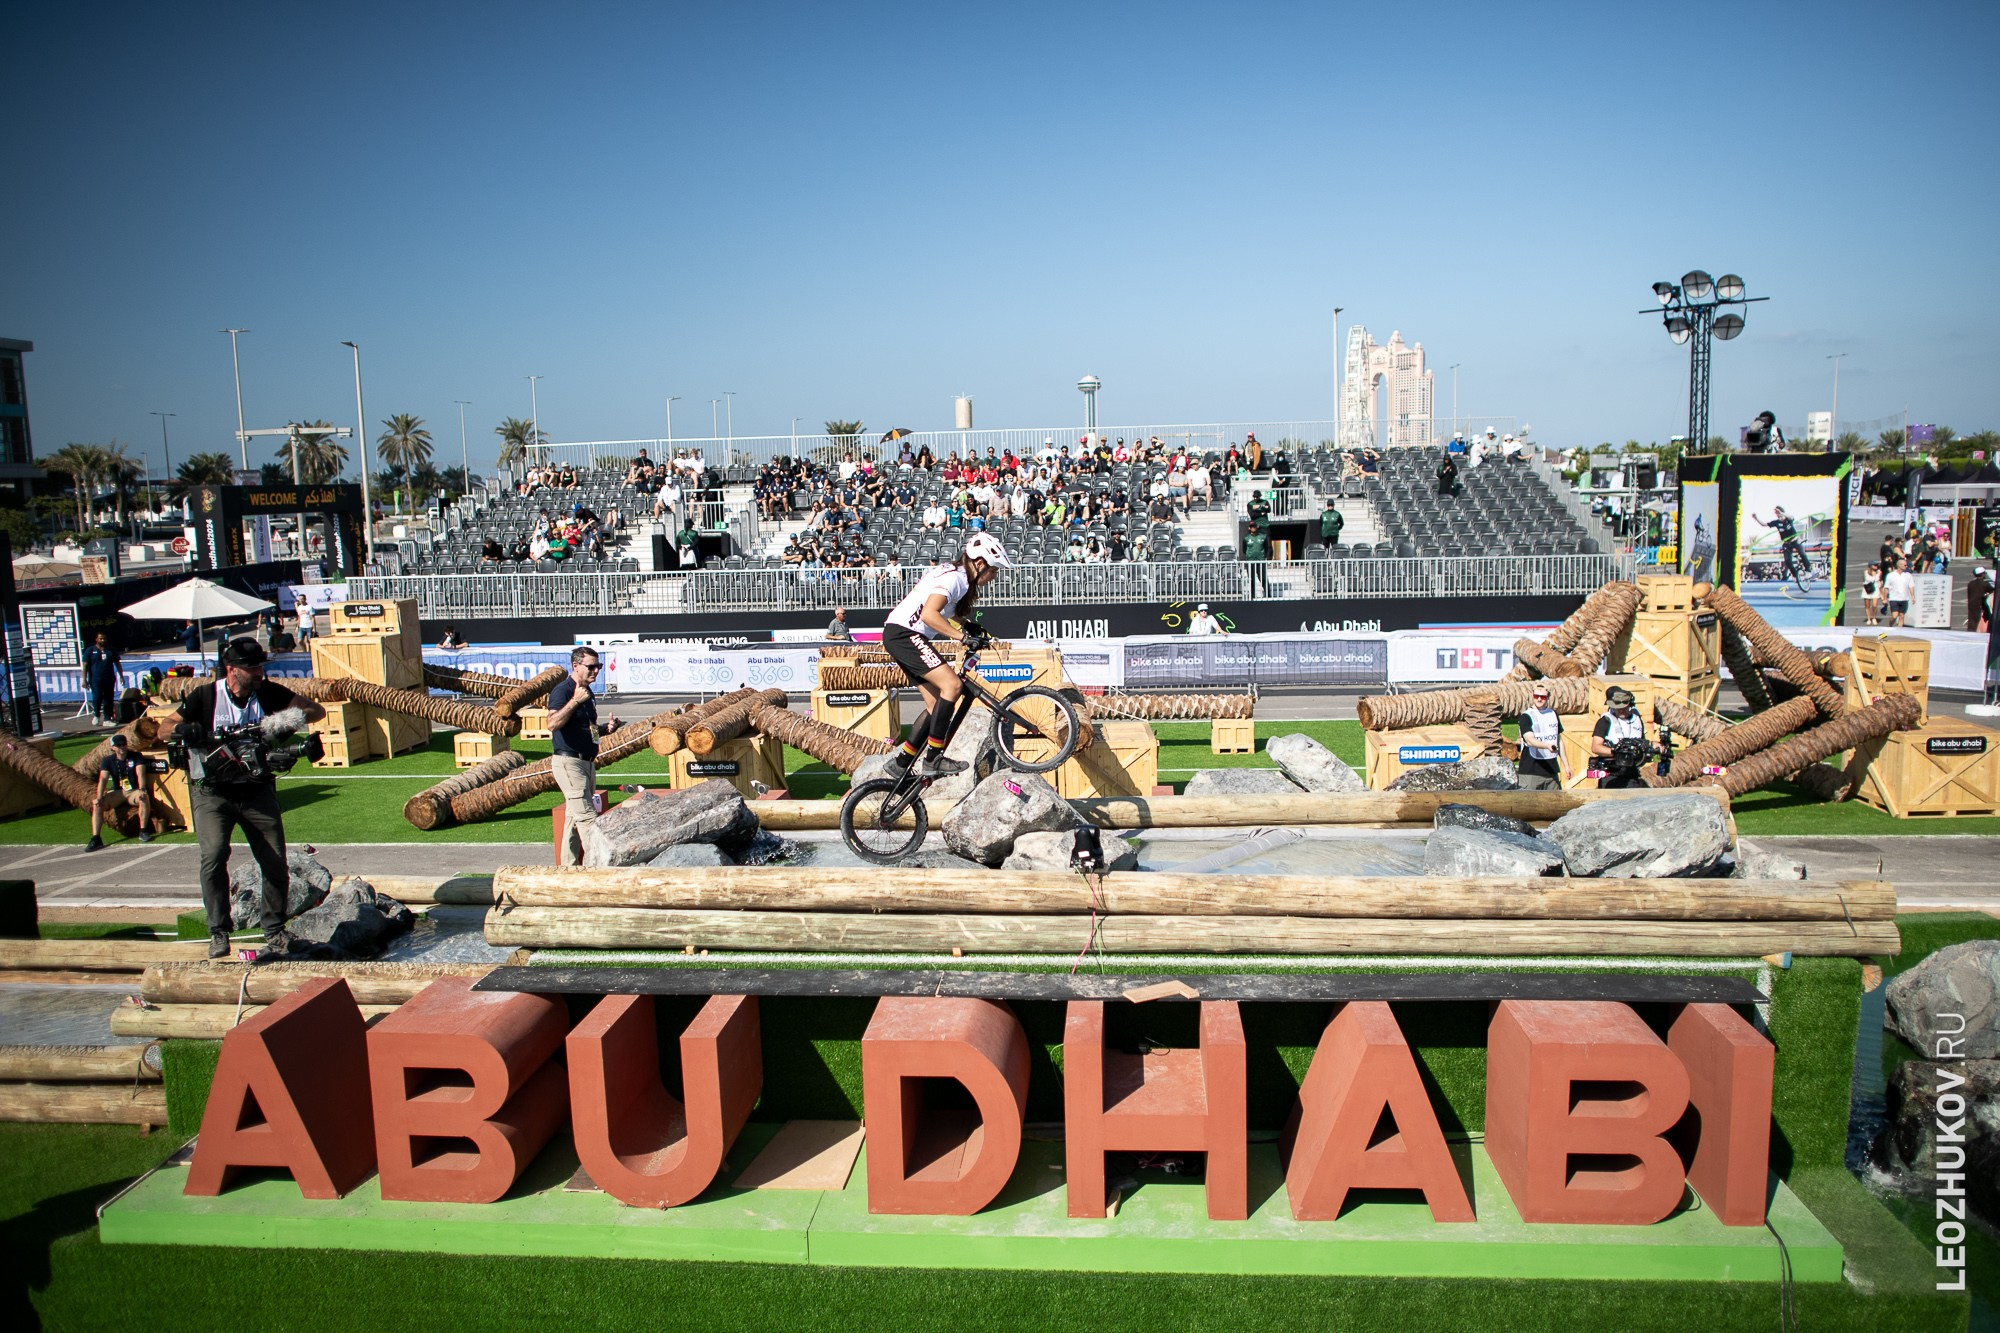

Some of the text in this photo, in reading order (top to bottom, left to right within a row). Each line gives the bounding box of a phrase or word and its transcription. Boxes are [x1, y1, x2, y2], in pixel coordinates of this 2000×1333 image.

[250, 493, 297, 506] WELCOME
[1026, 618, 1108, 639] ABU DHABI
[1314, 619, 1381, 632] Abu Dhabi
[705, 636, 748, 645] CYCLING
[909, 633, 942, 668] GERMANY
[687, 657, 702, 665] Abu
[764, 656, 785, 664] Dhabi
[1130, 655, 1203, 667] bike abu dhabi
[1214, 654, 1288, 665] bike abu dhabi
[1299, 653, 1373, 663] bike abu dhabi
[629, 665, 674, 685] 360
[688, 666, 734, 685] 360
[748, 665, 794, 685] 360
[977, 667, 1032, 678] SHIMANO
[1962, 739, 1982, 747] dhabi
[1400, 749, 1459, 760] SHIMANO
[184, 978, 1775, 1227] ABU DHABI
